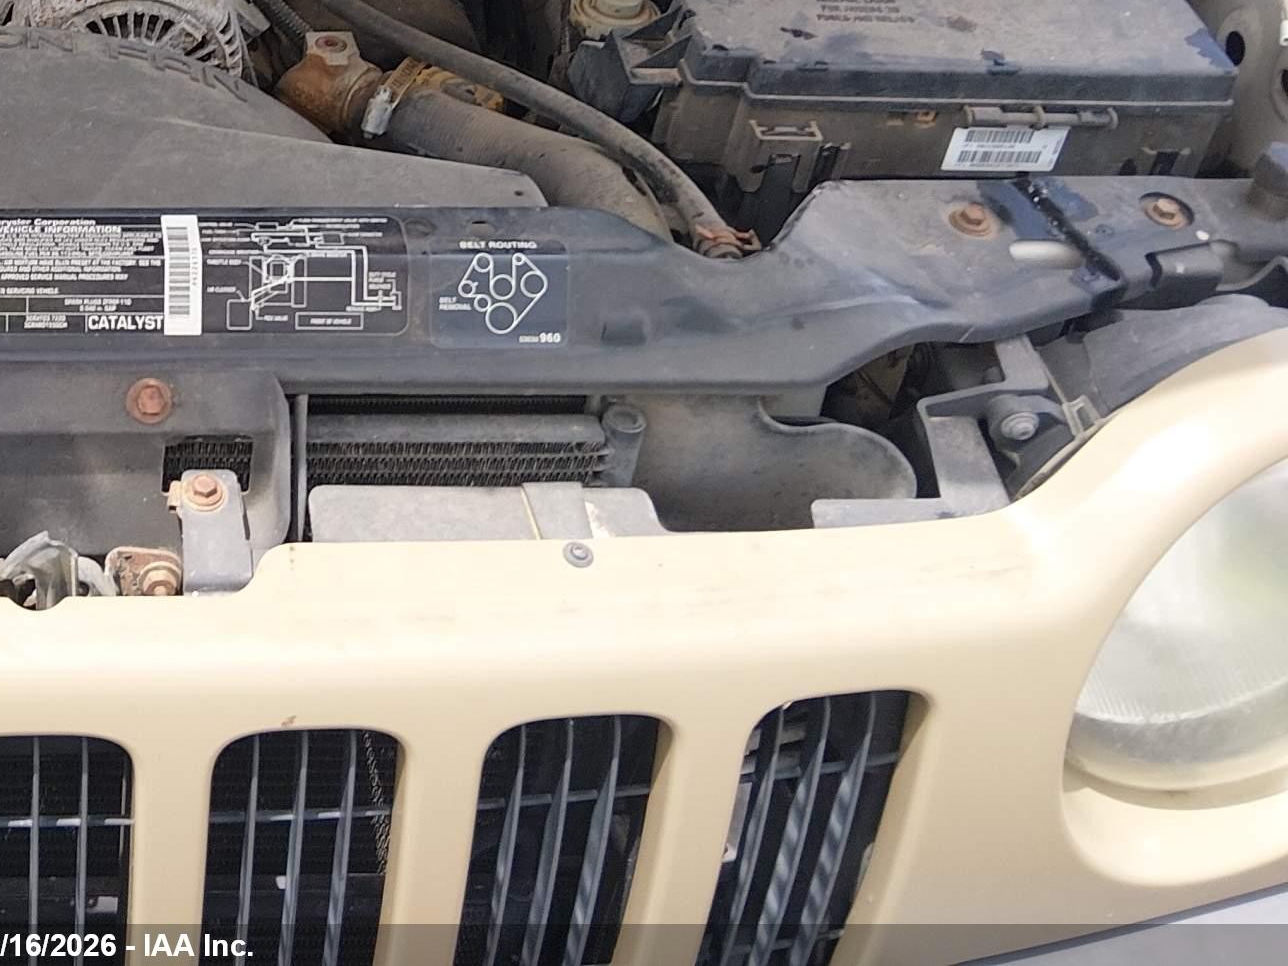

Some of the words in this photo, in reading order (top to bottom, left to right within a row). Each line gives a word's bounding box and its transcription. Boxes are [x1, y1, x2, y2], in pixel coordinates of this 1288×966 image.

[105, 43, 249, 103] FAN
[34, 218, 96, 227] Corporation
[44, 225, 122, 234] INFORMATION
[458, 240, 486, 249] BELT
[487, 240, 538, 249] ROUTING
[88, 315, 164, 330] CATALYST
